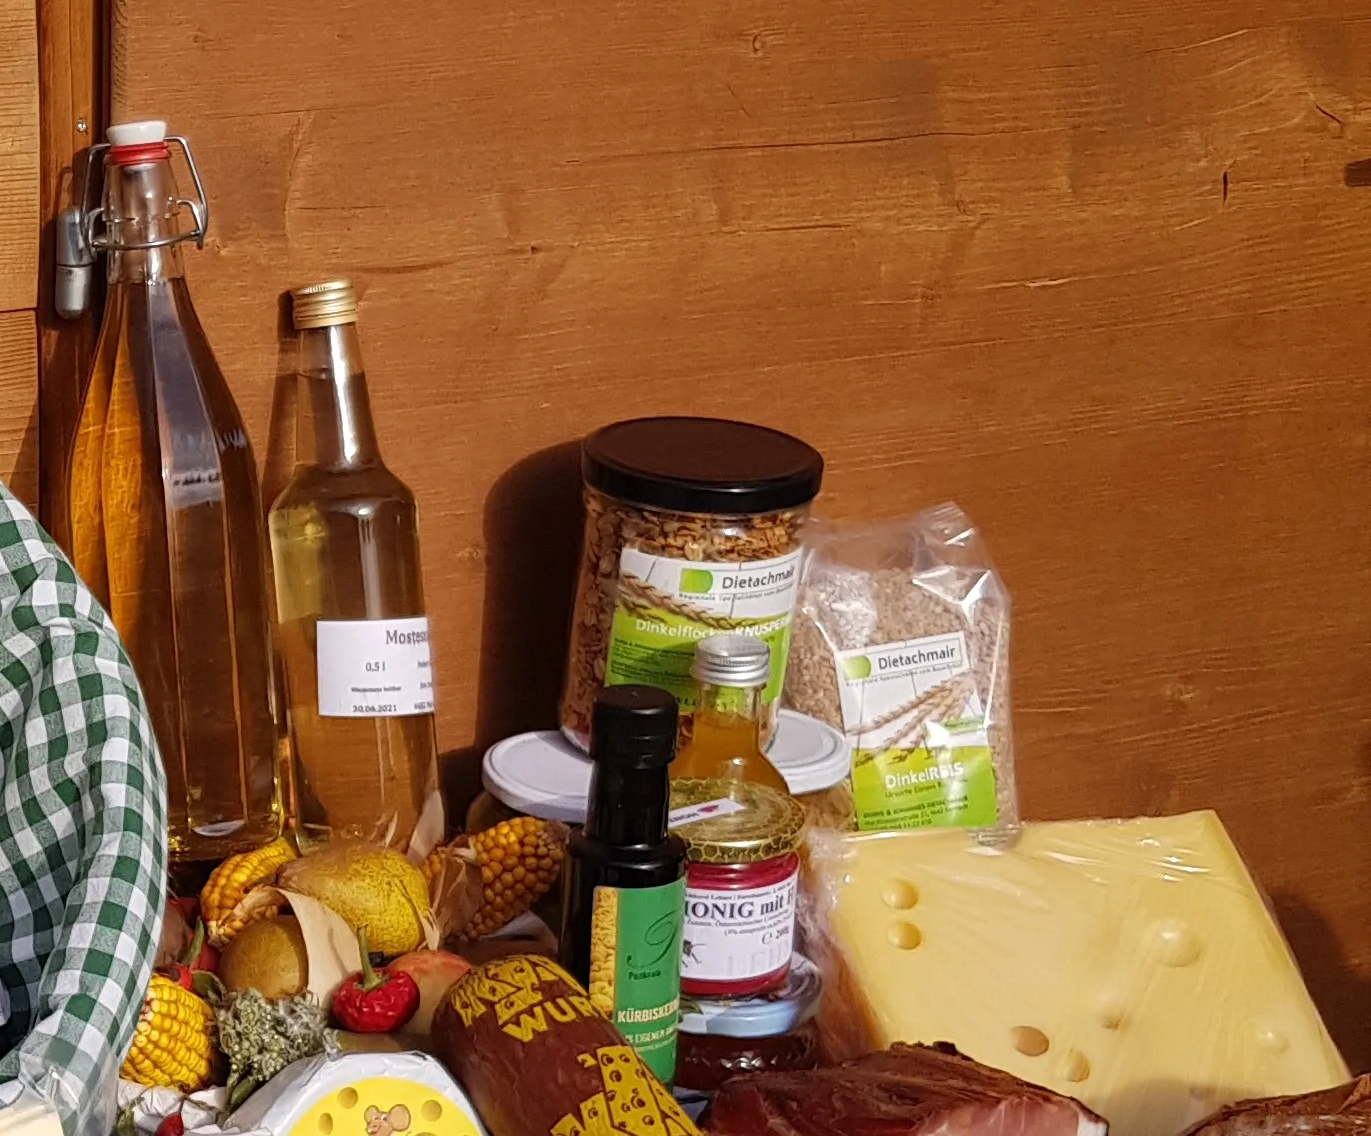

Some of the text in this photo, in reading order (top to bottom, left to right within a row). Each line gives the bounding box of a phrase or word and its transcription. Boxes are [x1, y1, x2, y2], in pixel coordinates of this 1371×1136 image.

[722, 566, 795, 590] Dietachmair
[878, 646, 955, 670] Dietachmair
[760, 895, 784, 916] mit
